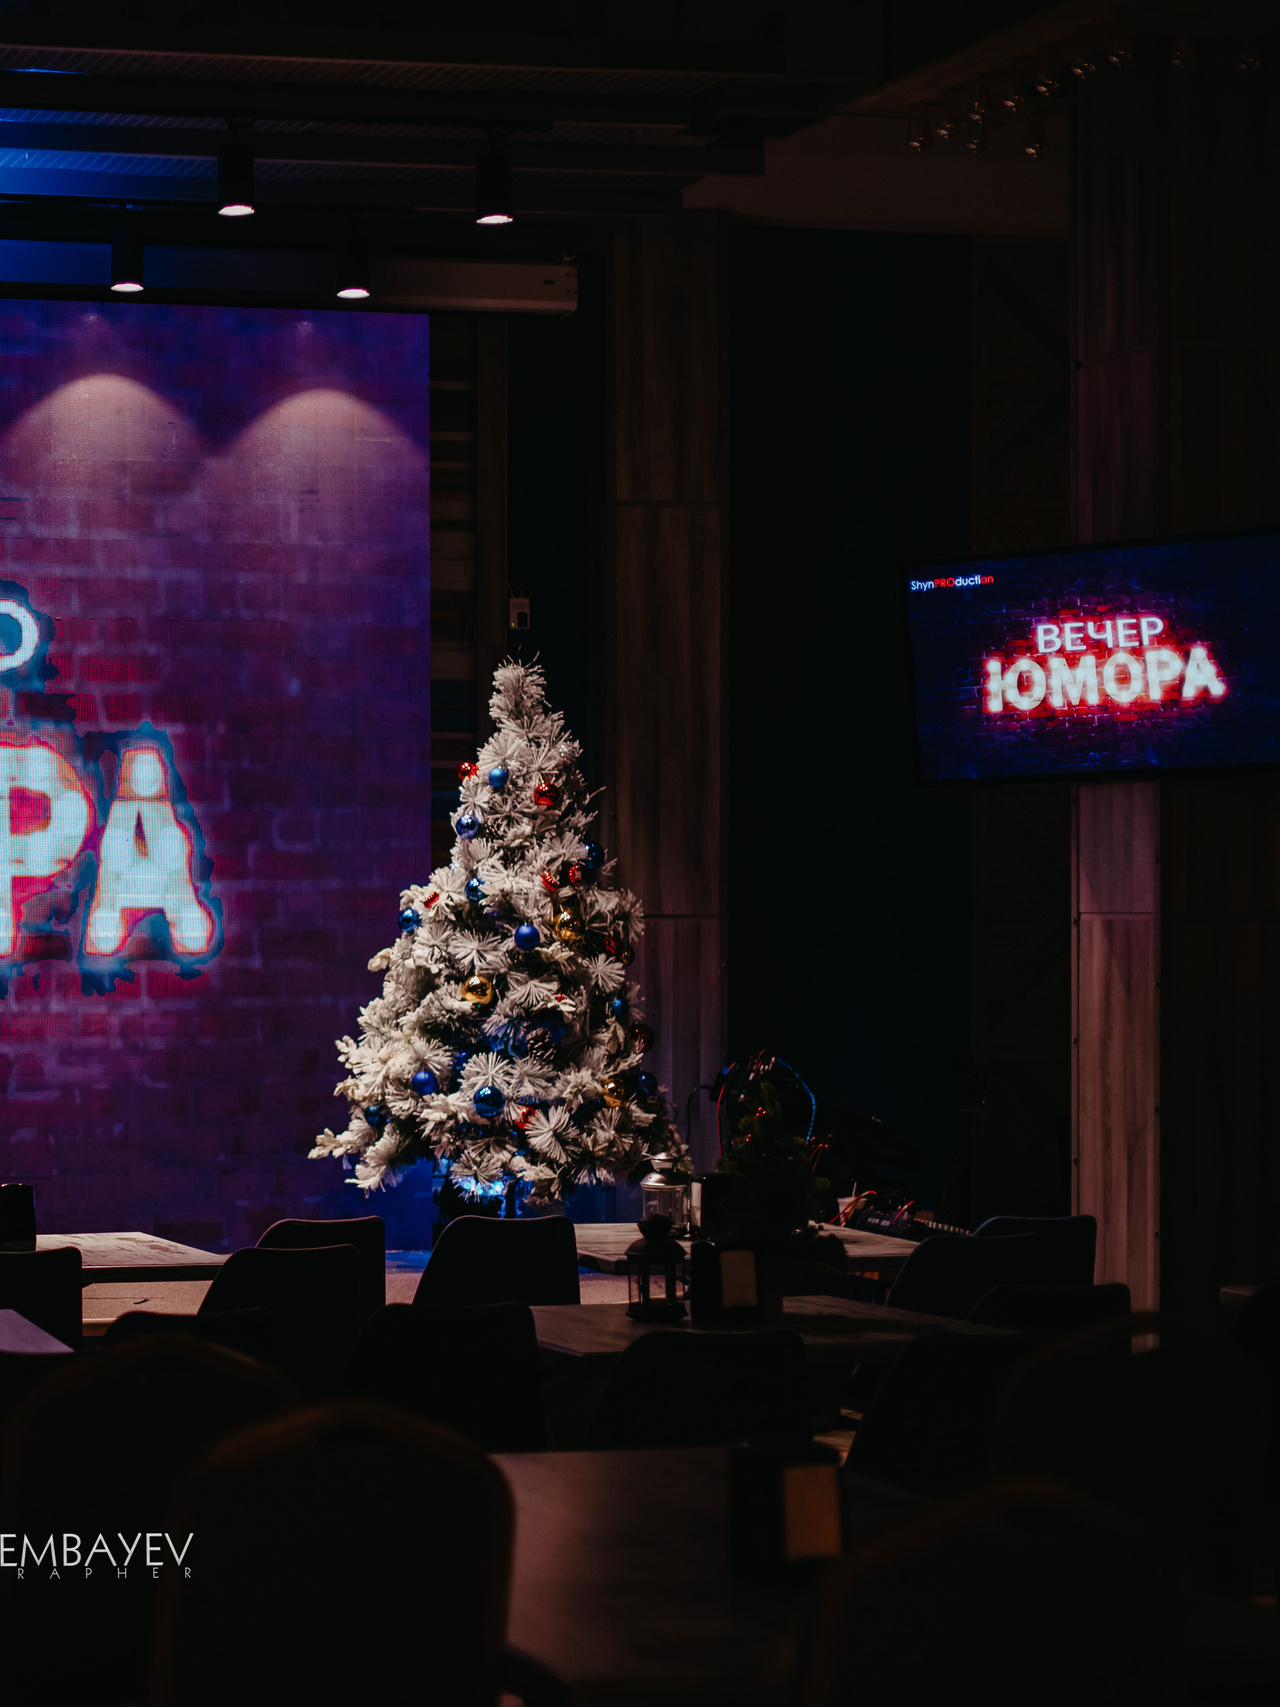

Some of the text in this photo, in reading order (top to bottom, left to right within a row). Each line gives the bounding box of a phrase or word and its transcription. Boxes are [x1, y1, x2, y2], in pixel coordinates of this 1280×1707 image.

[910, 574, 995, 591] ShynPROduction
[1037, 616, 1164, 654] ВЕЧЕР
[985, 646, 1224, 712] ЮМОРА
